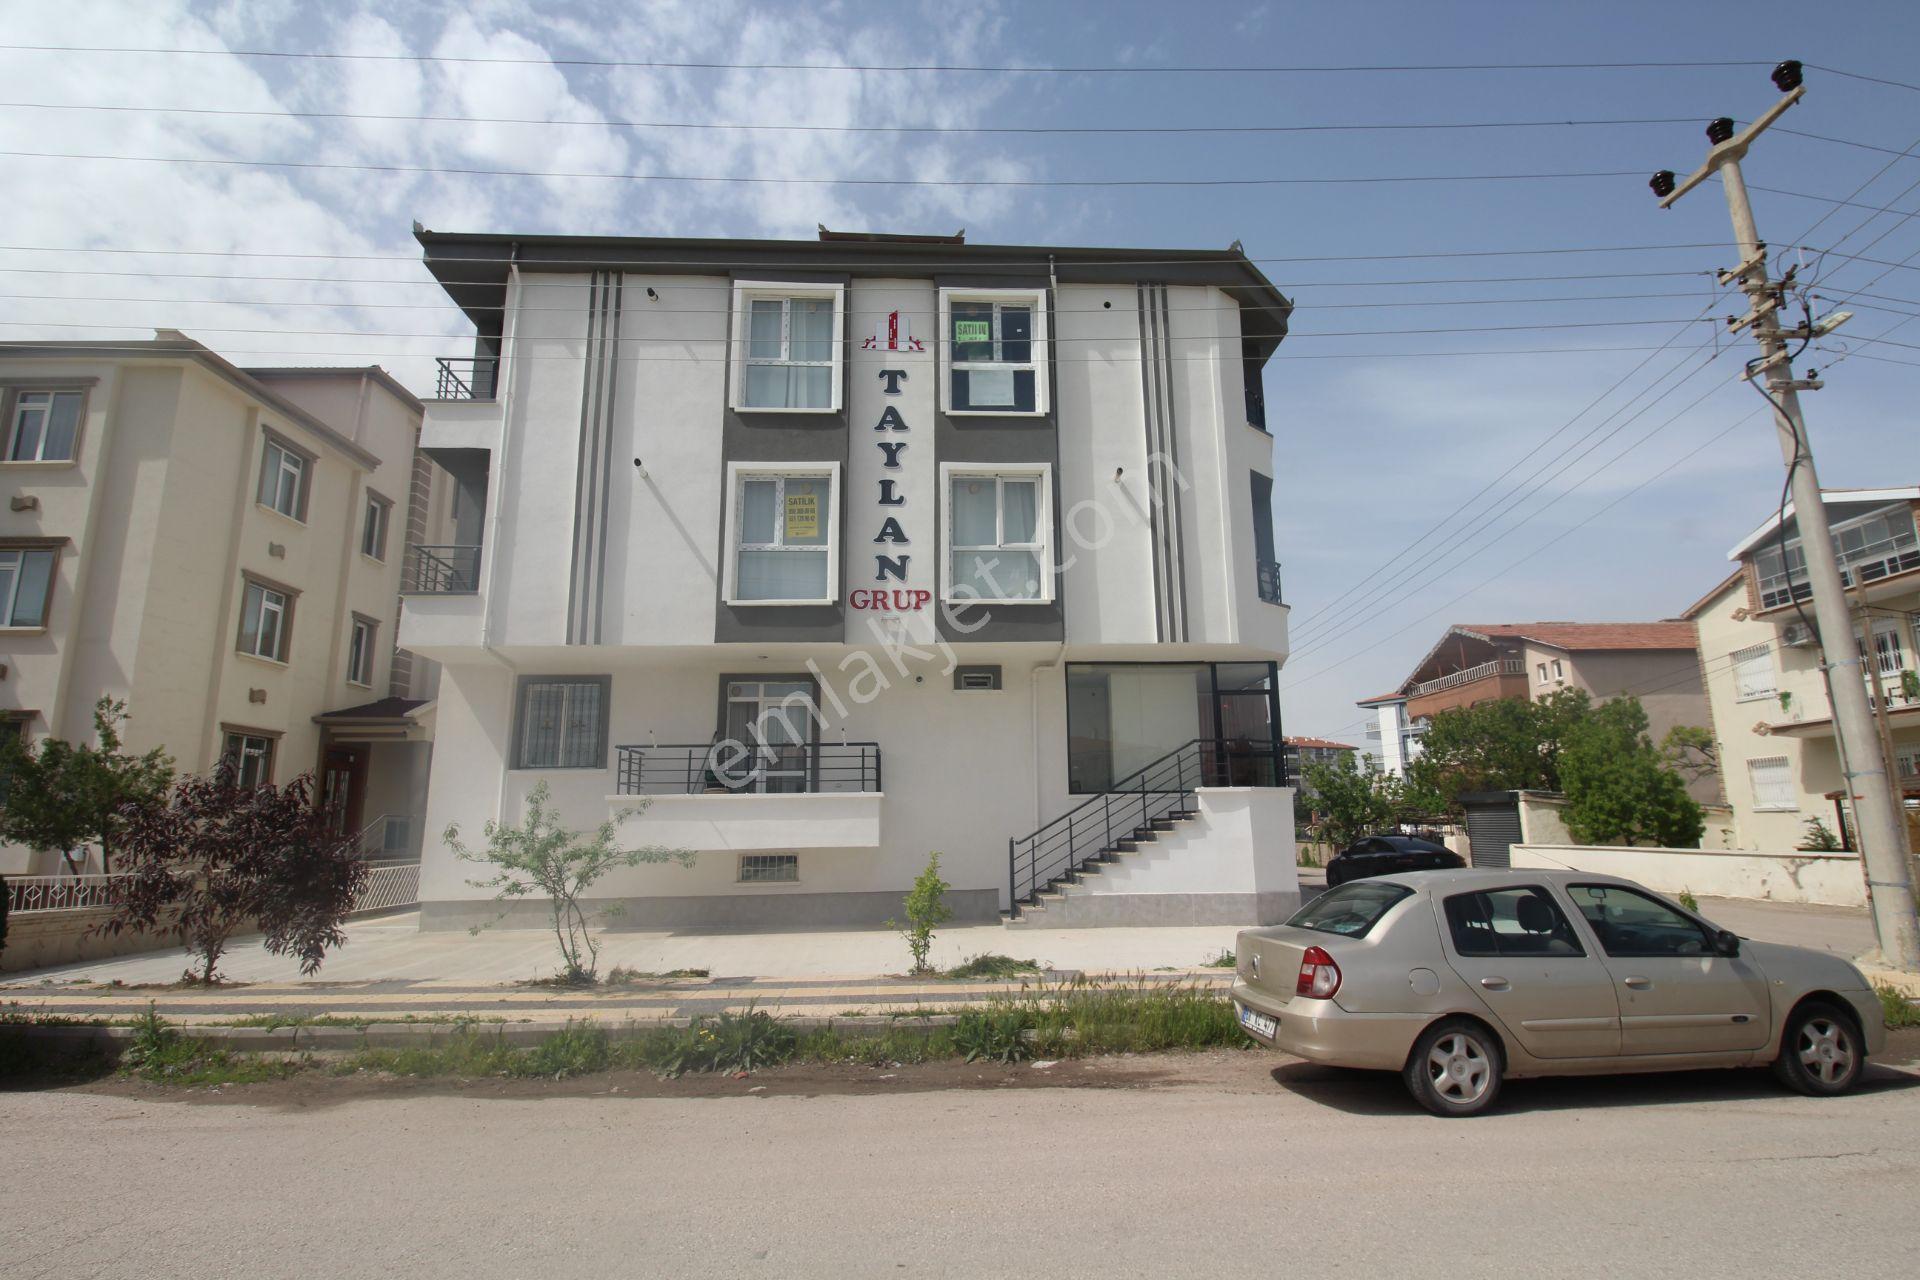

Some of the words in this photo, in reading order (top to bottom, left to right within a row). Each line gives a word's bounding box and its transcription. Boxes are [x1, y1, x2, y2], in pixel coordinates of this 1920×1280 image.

[873, 369, 910, 581] TAYLAN
[788, 497, 815, 505] SATILIK
[850, 589, 931, 611] GRUP
